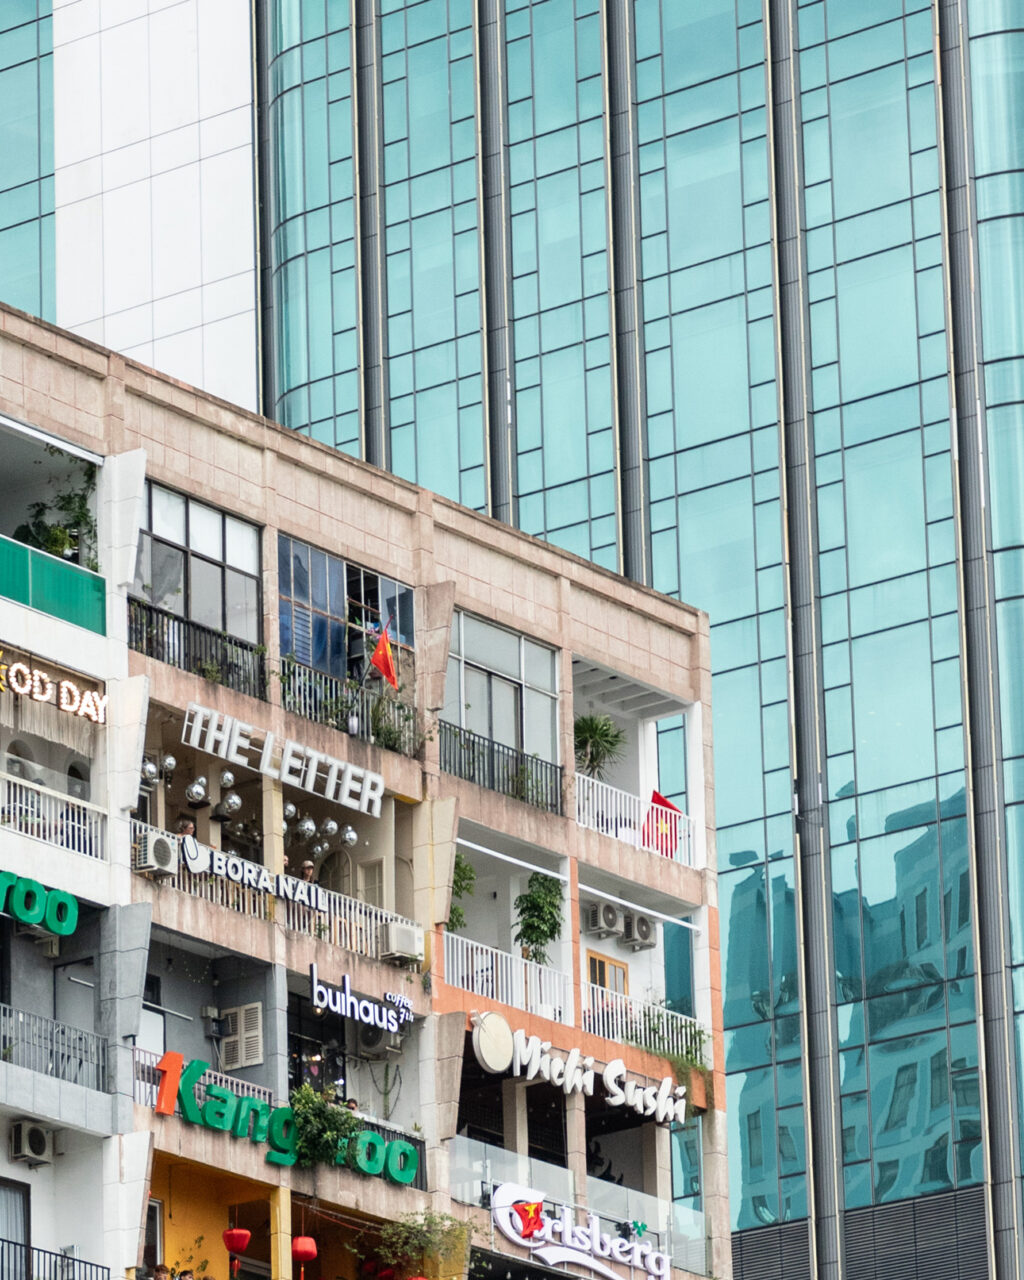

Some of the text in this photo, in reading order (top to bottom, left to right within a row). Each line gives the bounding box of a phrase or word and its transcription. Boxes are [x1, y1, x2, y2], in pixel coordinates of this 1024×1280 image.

[58, 680, 108, 724] DAY
[188, 703, 385, 818] THE LETTER
[212, 852, 328, 912] BORA NAIL
[384, 991, 413, 1010] coffee
[512, 1029, 687, 1124] Michi Sushi
[155, 1051, 419, 1184] Kangoo
